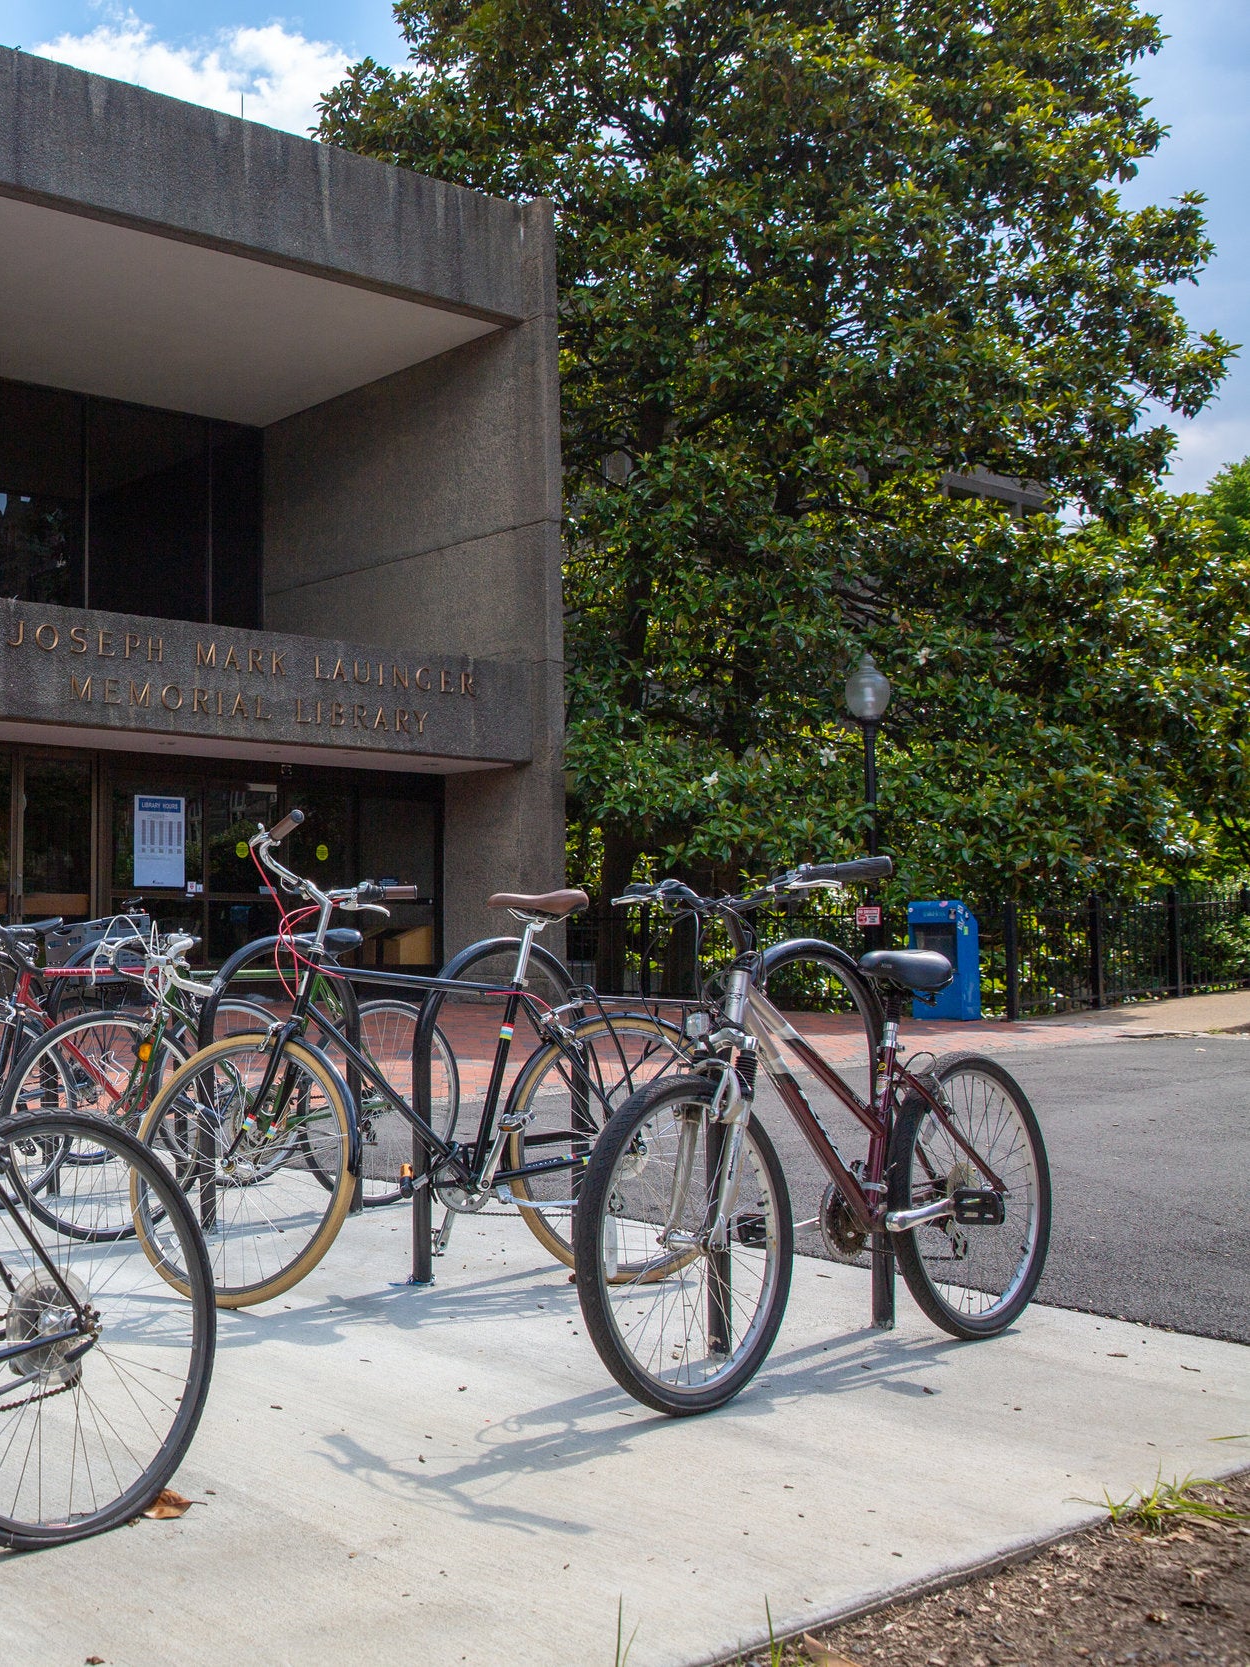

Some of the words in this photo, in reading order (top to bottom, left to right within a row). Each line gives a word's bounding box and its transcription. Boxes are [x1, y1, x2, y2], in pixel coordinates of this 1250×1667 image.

[6, 620, 163, 662] JOSEPH
[196, 640, 287, 676] MARK
[314, 655, 475, 697] LAUINGER
[70, 674, 272, 719] MEMORIAL
[296, 698, 429, 733] LIBRARY
[141, 801, 161, 809] LIBRARY
